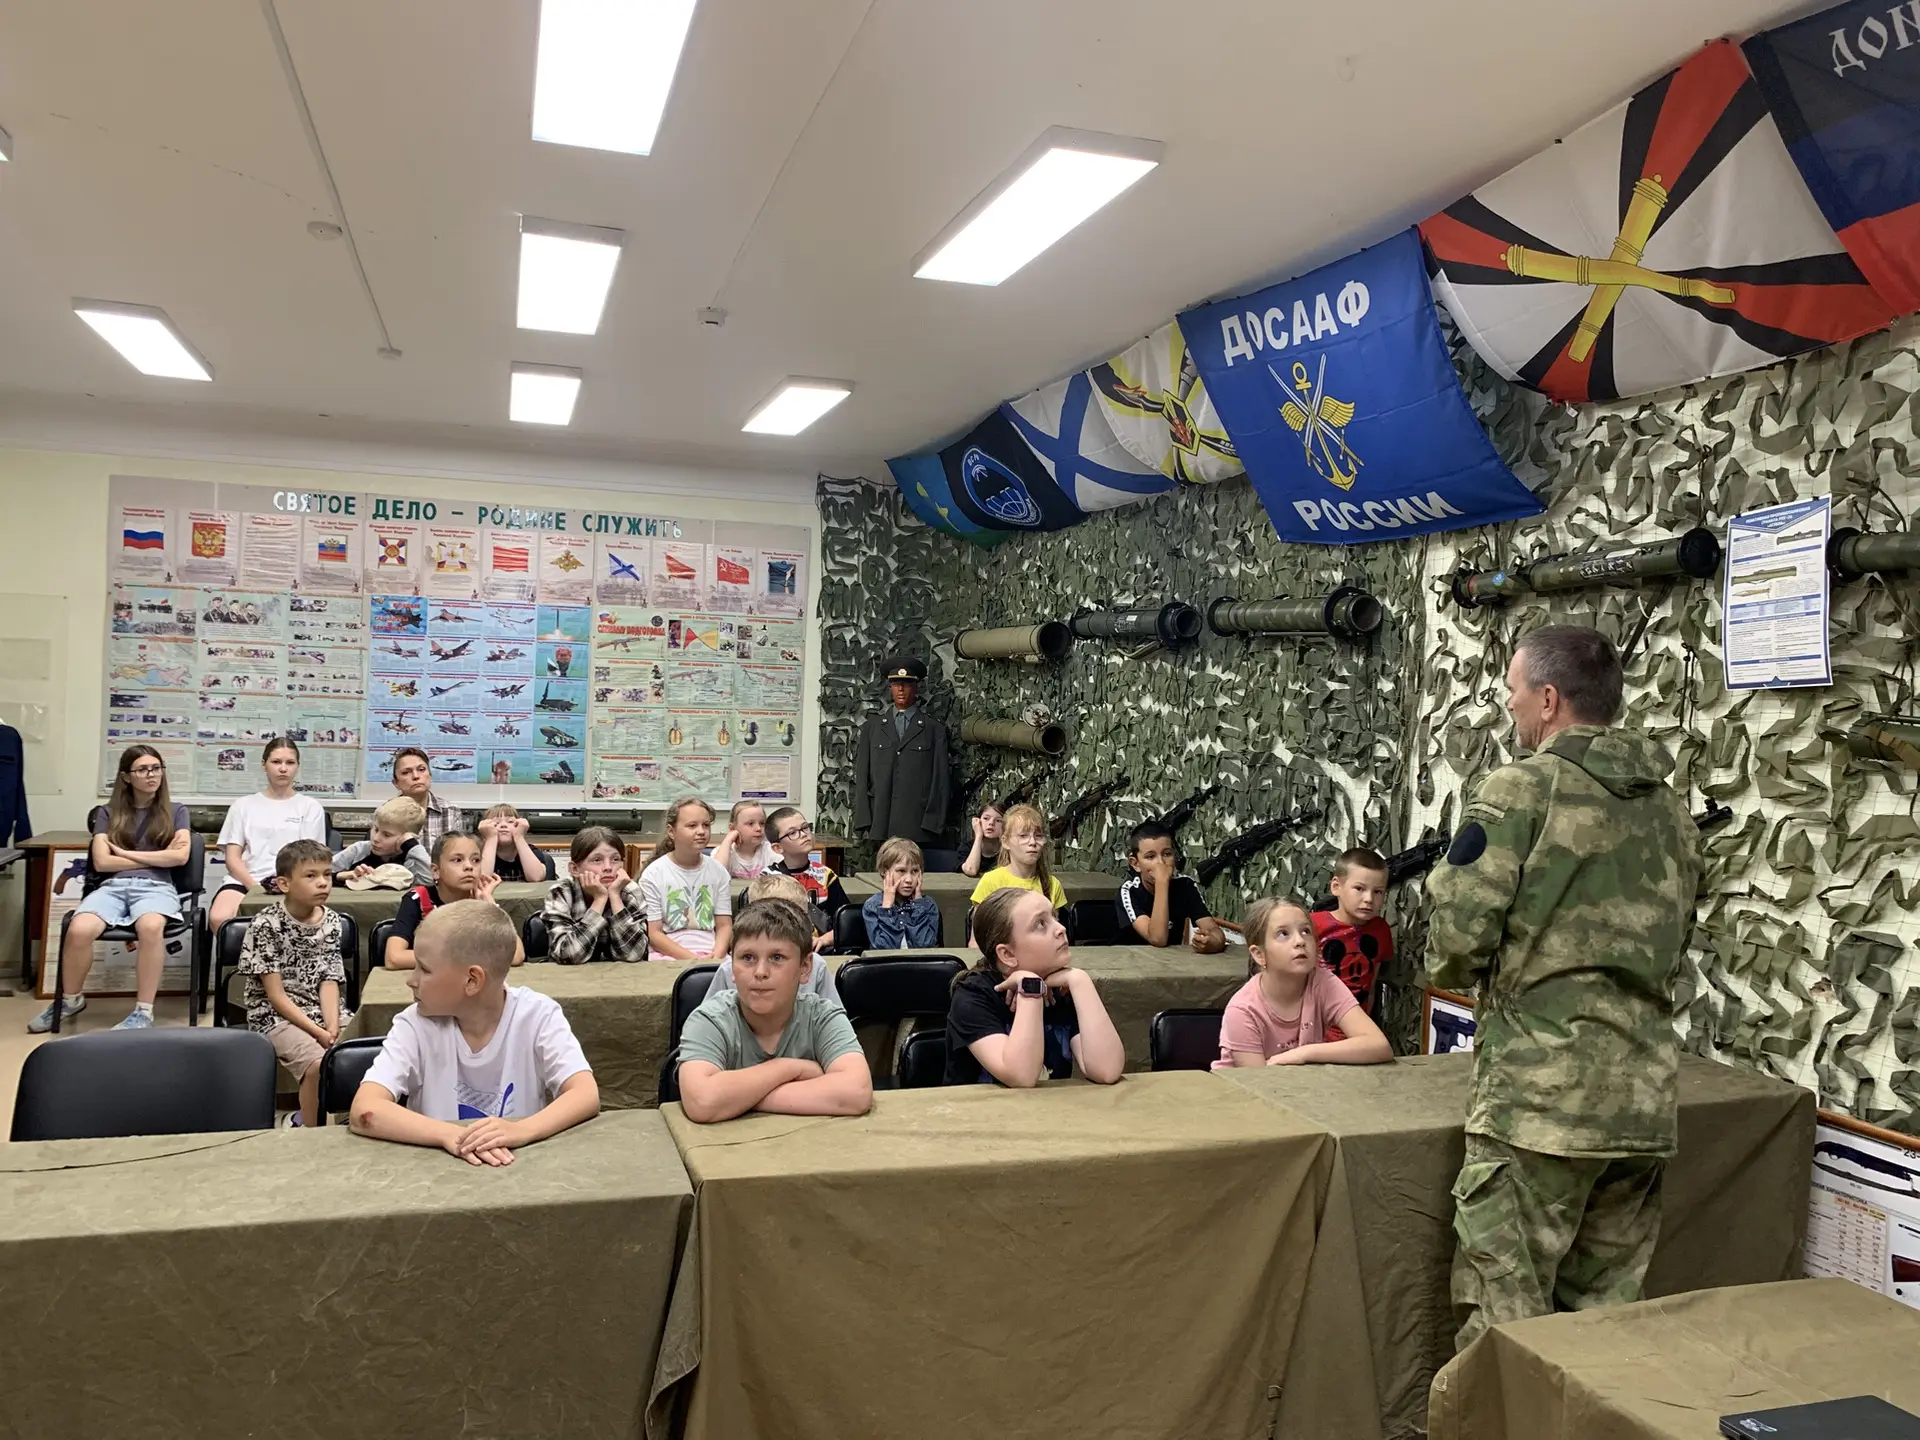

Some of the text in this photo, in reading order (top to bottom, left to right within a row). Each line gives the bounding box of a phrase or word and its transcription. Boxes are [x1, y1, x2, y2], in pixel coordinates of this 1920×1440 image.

[1221, 280, 1370, 367] ДОСААФ
[273, 491, 356, 516] СВЯТОЕ
[372, 498, 437, 521] ДЕЛО
[478, 506, 567, 530] РОДИНЕ
[582, 514, 683, 538] СЛУЖИТЬ
[1292, 491, 1465, 531] РОССИИ
